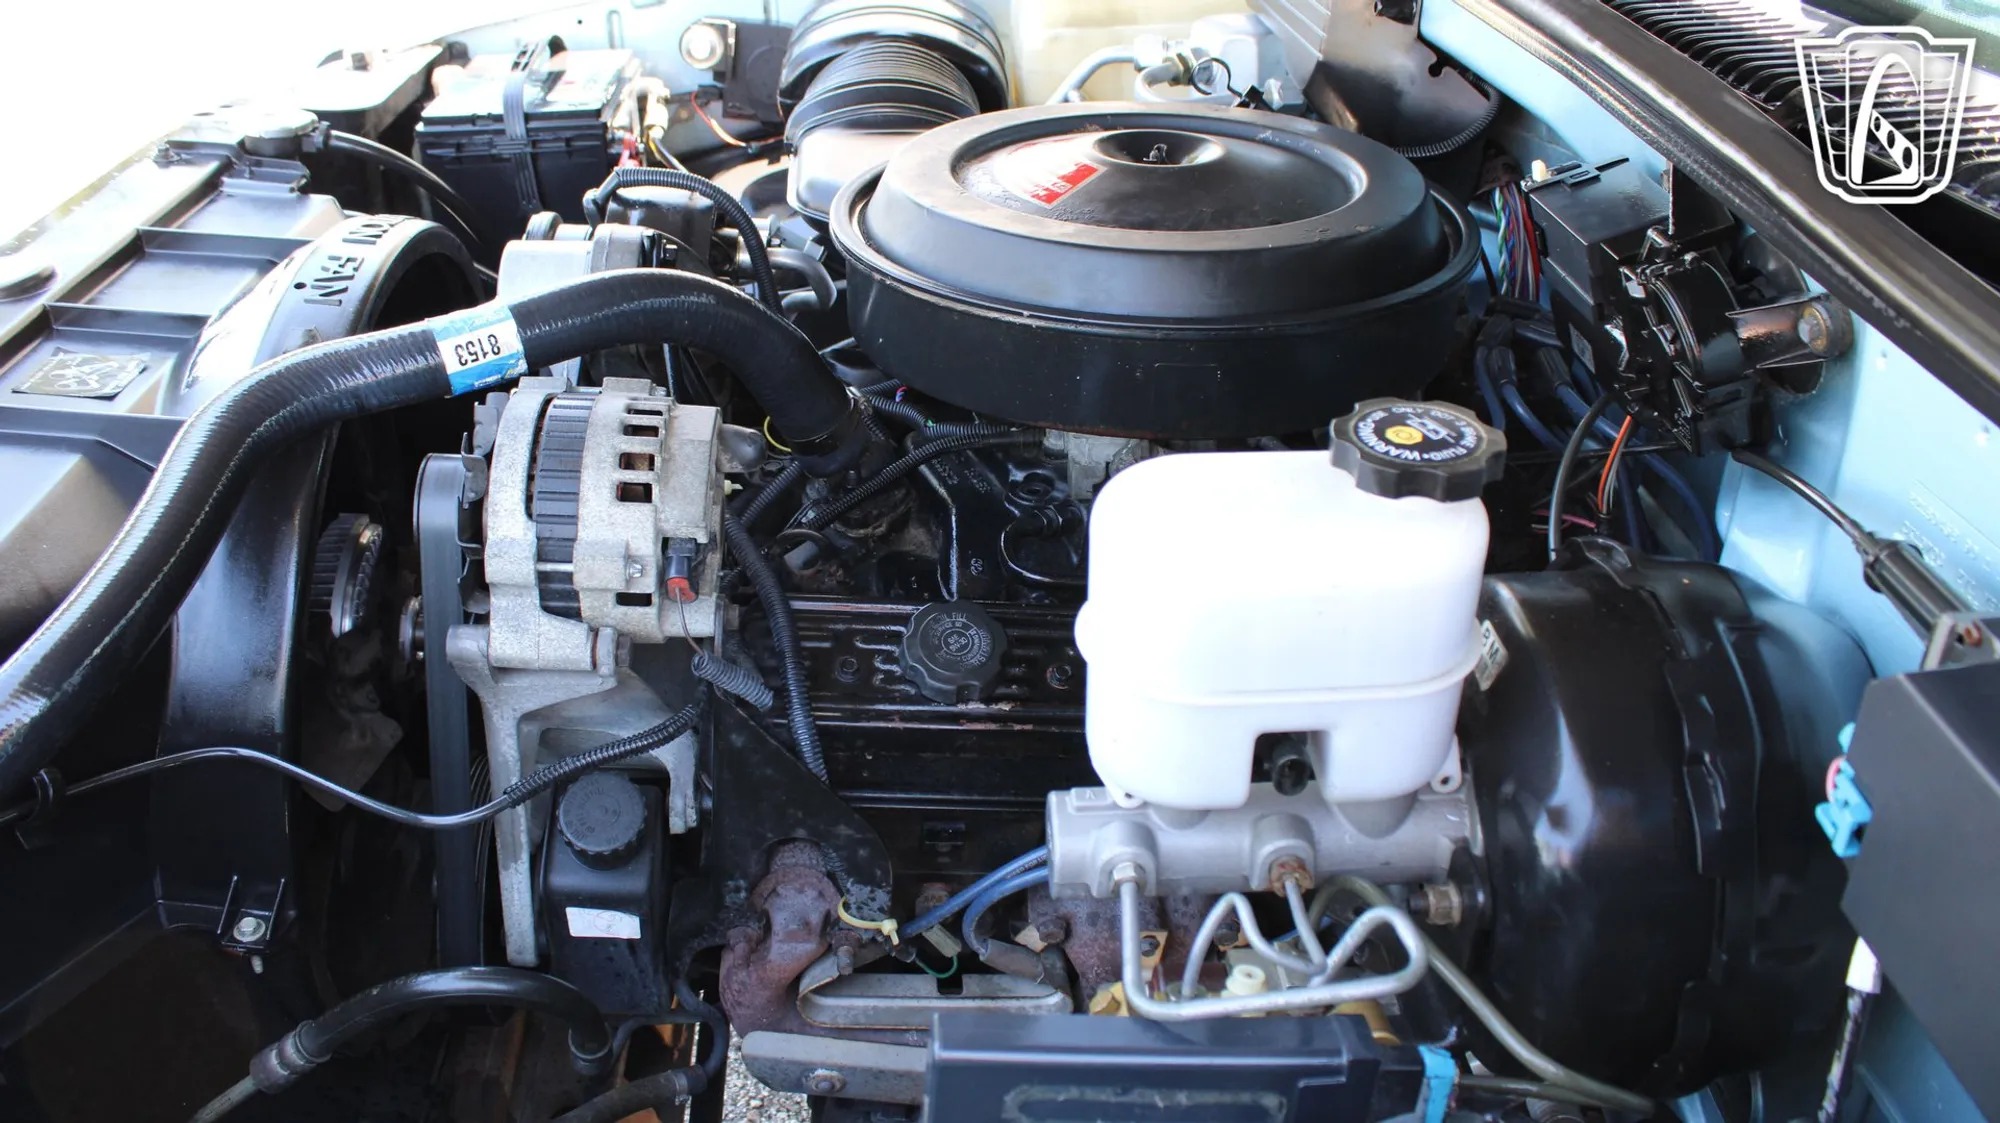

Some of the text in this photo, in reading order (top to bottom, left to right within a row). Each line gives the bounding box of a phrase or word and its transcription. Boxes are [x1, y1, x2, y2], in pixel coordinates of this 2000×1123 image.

[304, 255, 364, 306] FAN
[454, 334, 501, 367] 8153
[1429, 445, 1468, 461] FLUID
[951, 612, 967, 621] FILL
